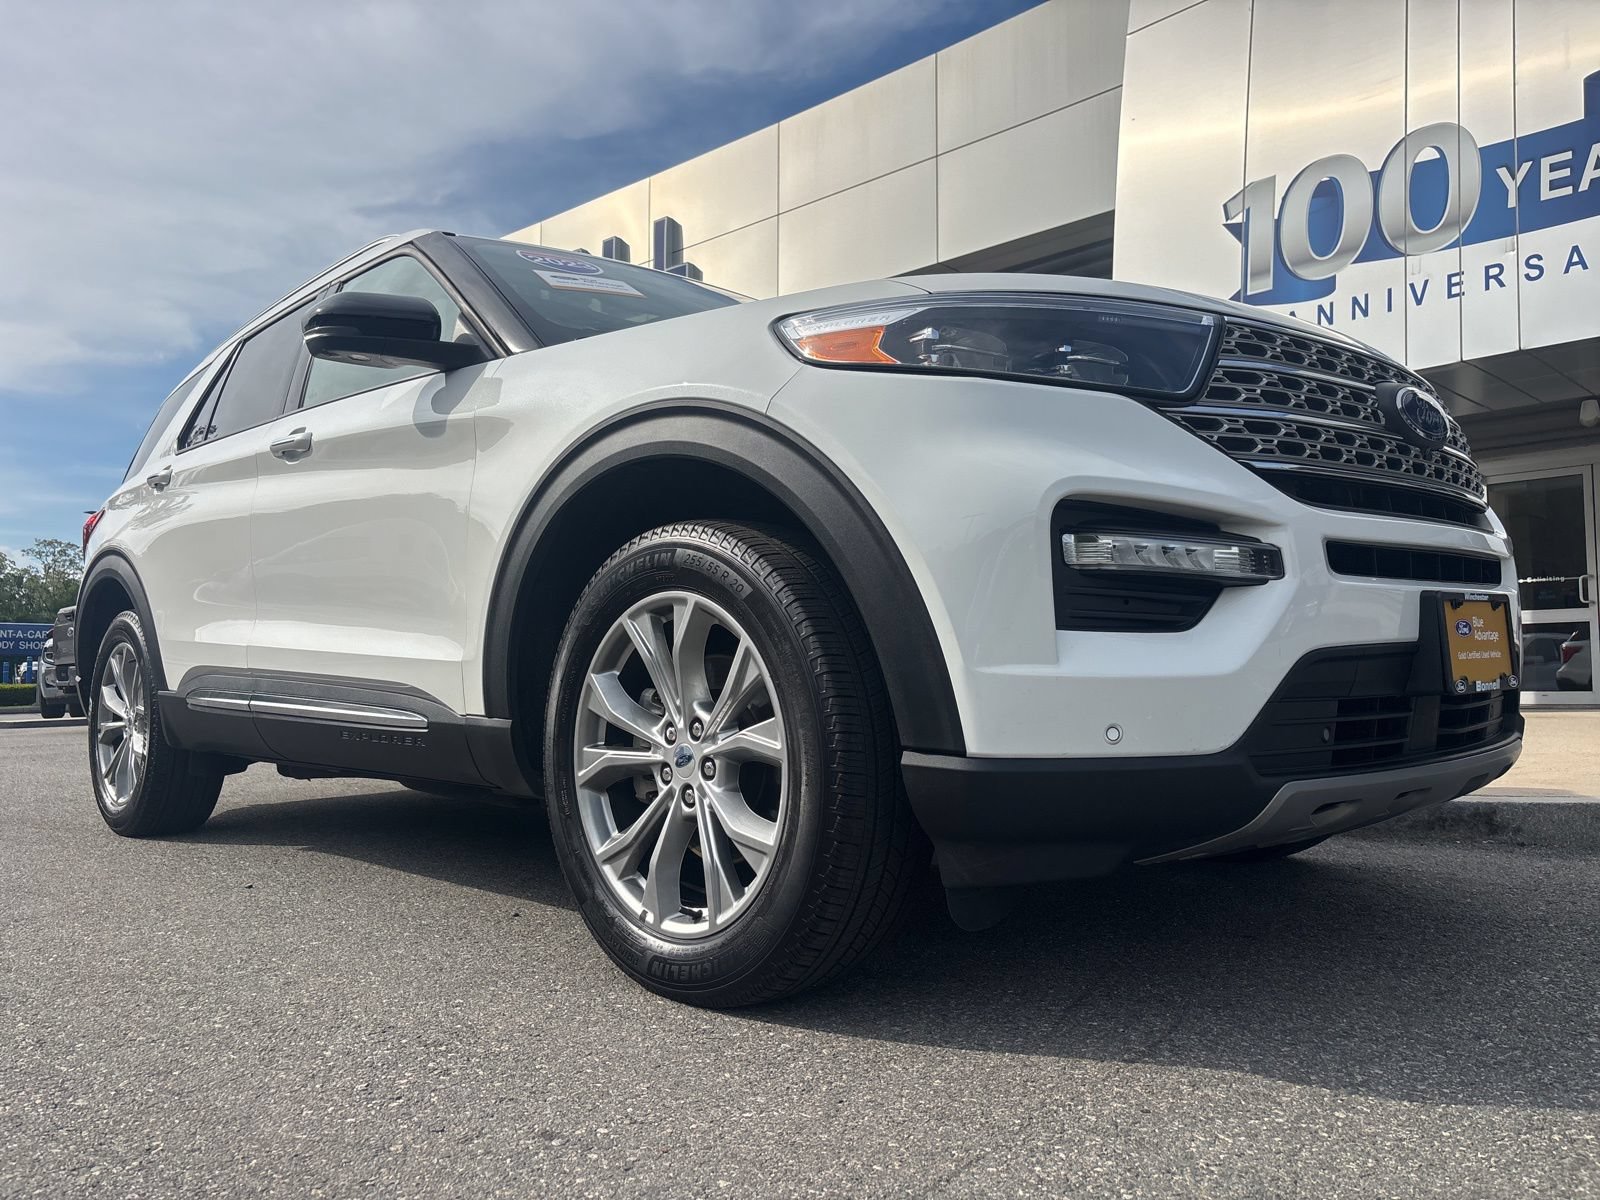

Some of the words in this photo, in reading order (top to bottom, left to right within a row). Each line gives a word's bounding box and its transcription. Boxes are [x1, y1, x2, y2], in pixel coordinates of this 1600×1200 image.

[1222, 122, 1482, 296] 100
[683, 553, 720, 576] 255/55
[719, 571, 729, 581] R
[731, 580, 745, 593] 20
[1472, 616, 1484, 628] Blue
[1474, 630, 1499, 642] Advantage
